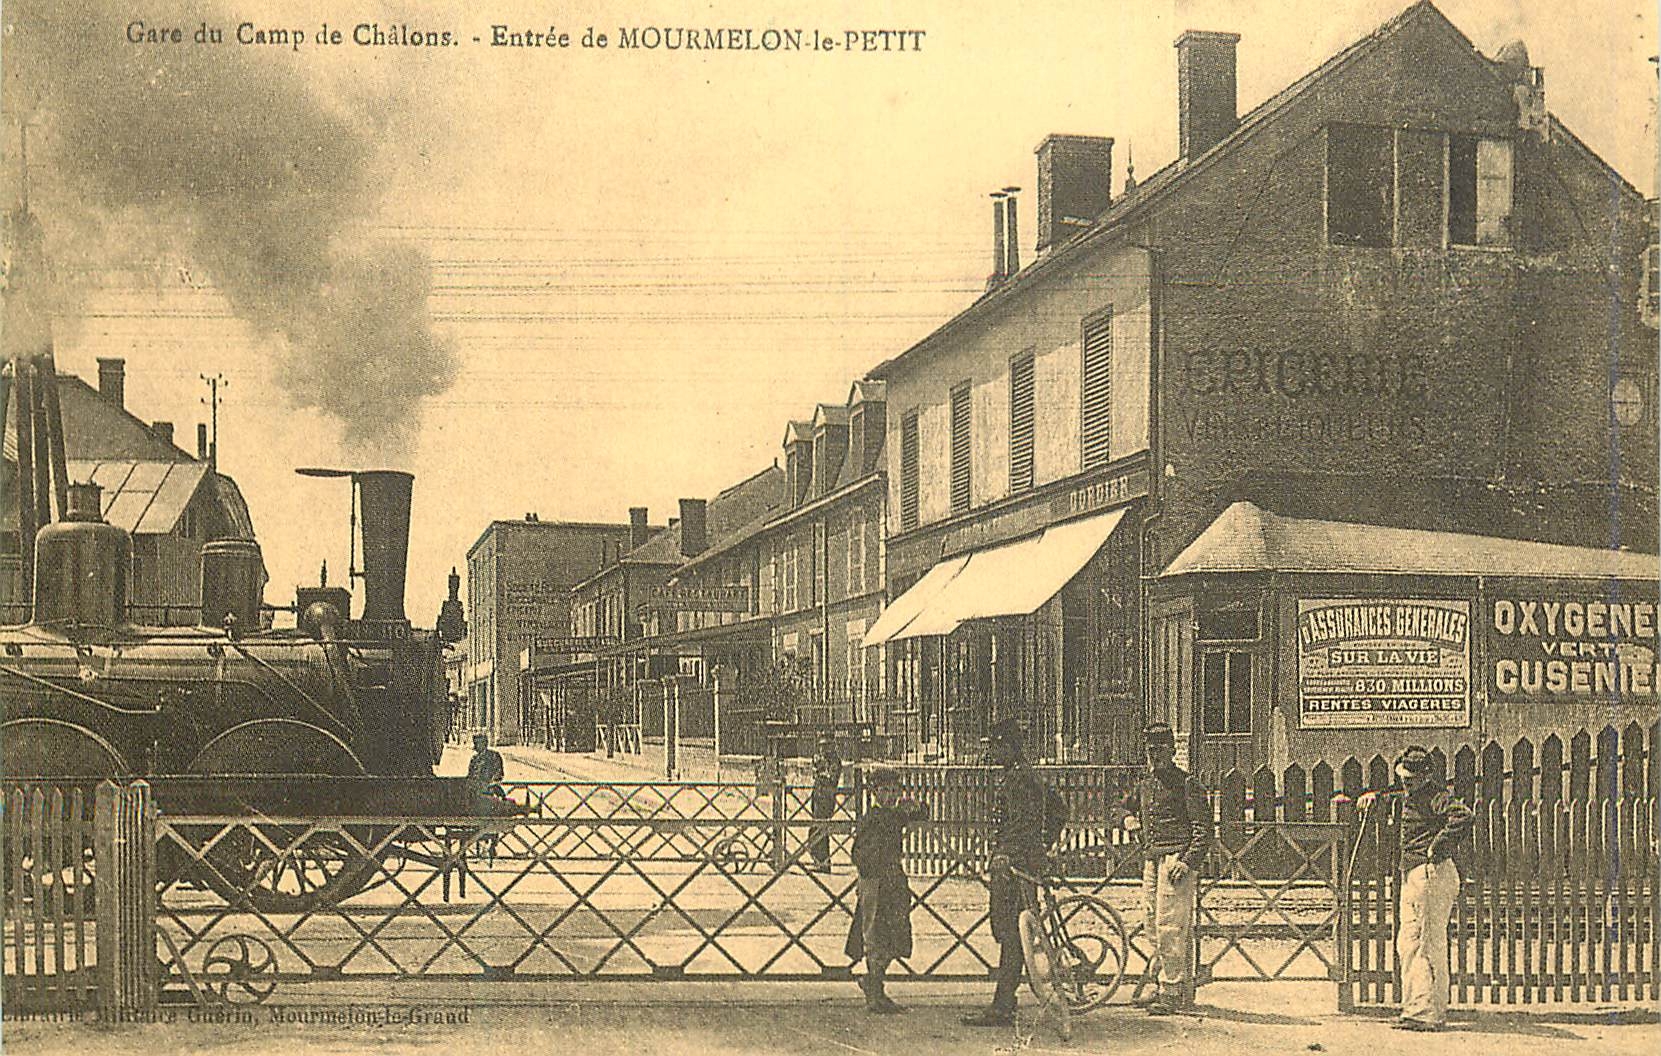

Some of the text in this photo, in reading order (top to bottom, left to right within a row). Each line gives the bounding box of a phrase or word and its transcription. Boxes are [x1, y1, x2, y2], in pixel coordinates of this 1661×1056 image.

[1331, 651, 1370, 664] SUR
[1377, 652, 1402, 664] LA
[1404, 652, 1439, 664] VIE
[1496, 659, 1660, 695] CUSENIE
[1391, 679, 1464, 693] MILLIONS
[1309, 699, 1372, 711] RENTES
